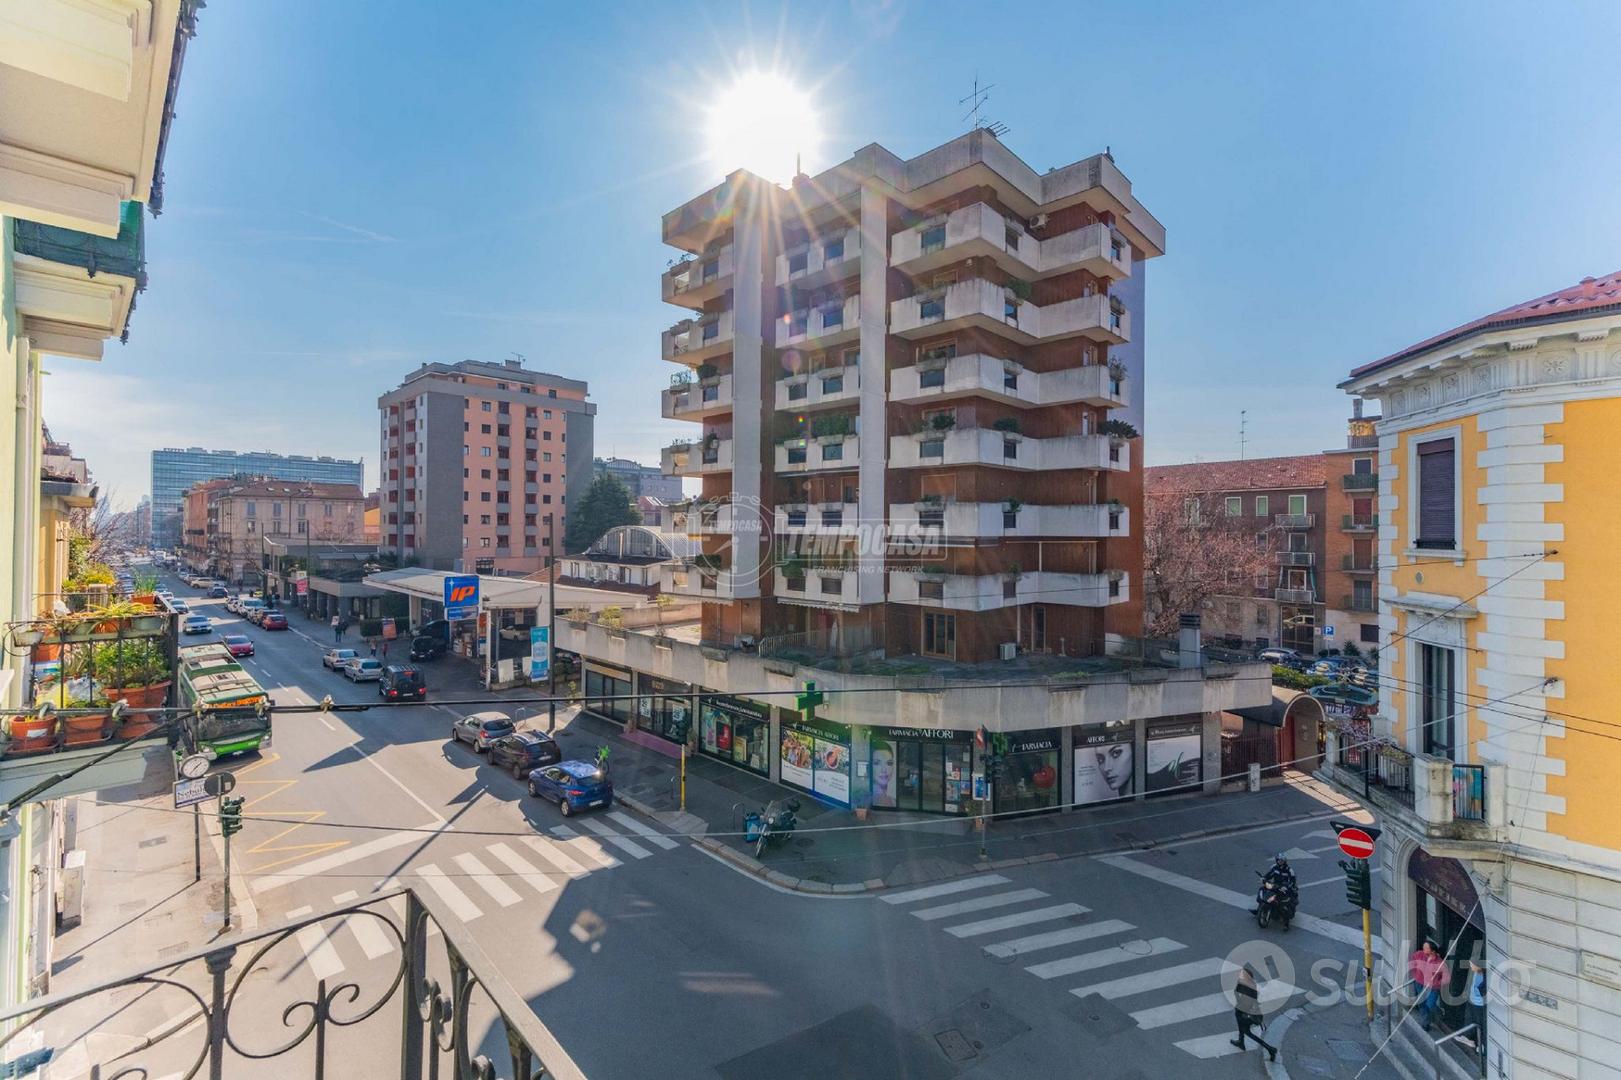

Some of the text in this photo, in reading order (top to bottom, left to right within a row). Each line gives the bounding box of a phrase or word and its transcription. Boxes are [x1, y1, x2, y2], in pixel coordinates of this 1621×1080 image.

[449, 585, 475, 602] IP
[888, 728, 954, 739] FARMACIA AFFORI
[1021, 741, 1053, 751] FARMACIA
